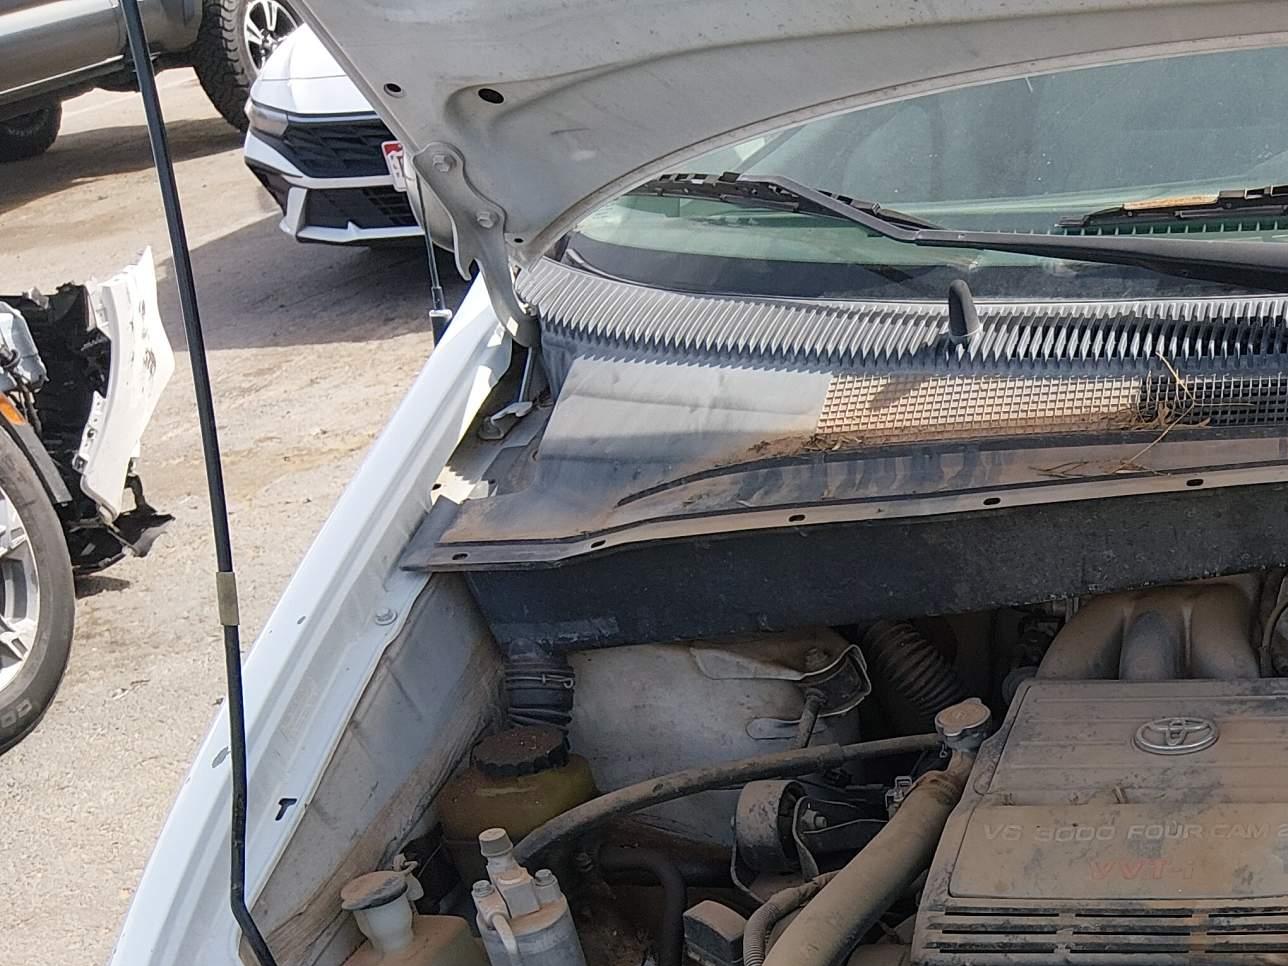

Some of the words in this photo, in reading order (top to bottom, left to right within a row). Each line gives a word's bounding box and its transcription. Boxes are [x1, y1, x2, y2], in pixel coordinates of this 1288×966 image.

[983, 823, 1022, 840] V6
[1034, 824, 1116, 841] 3000
[1127, 823, 1203, 840] FOUR
[1211, 823, 1269, 840] CAM
